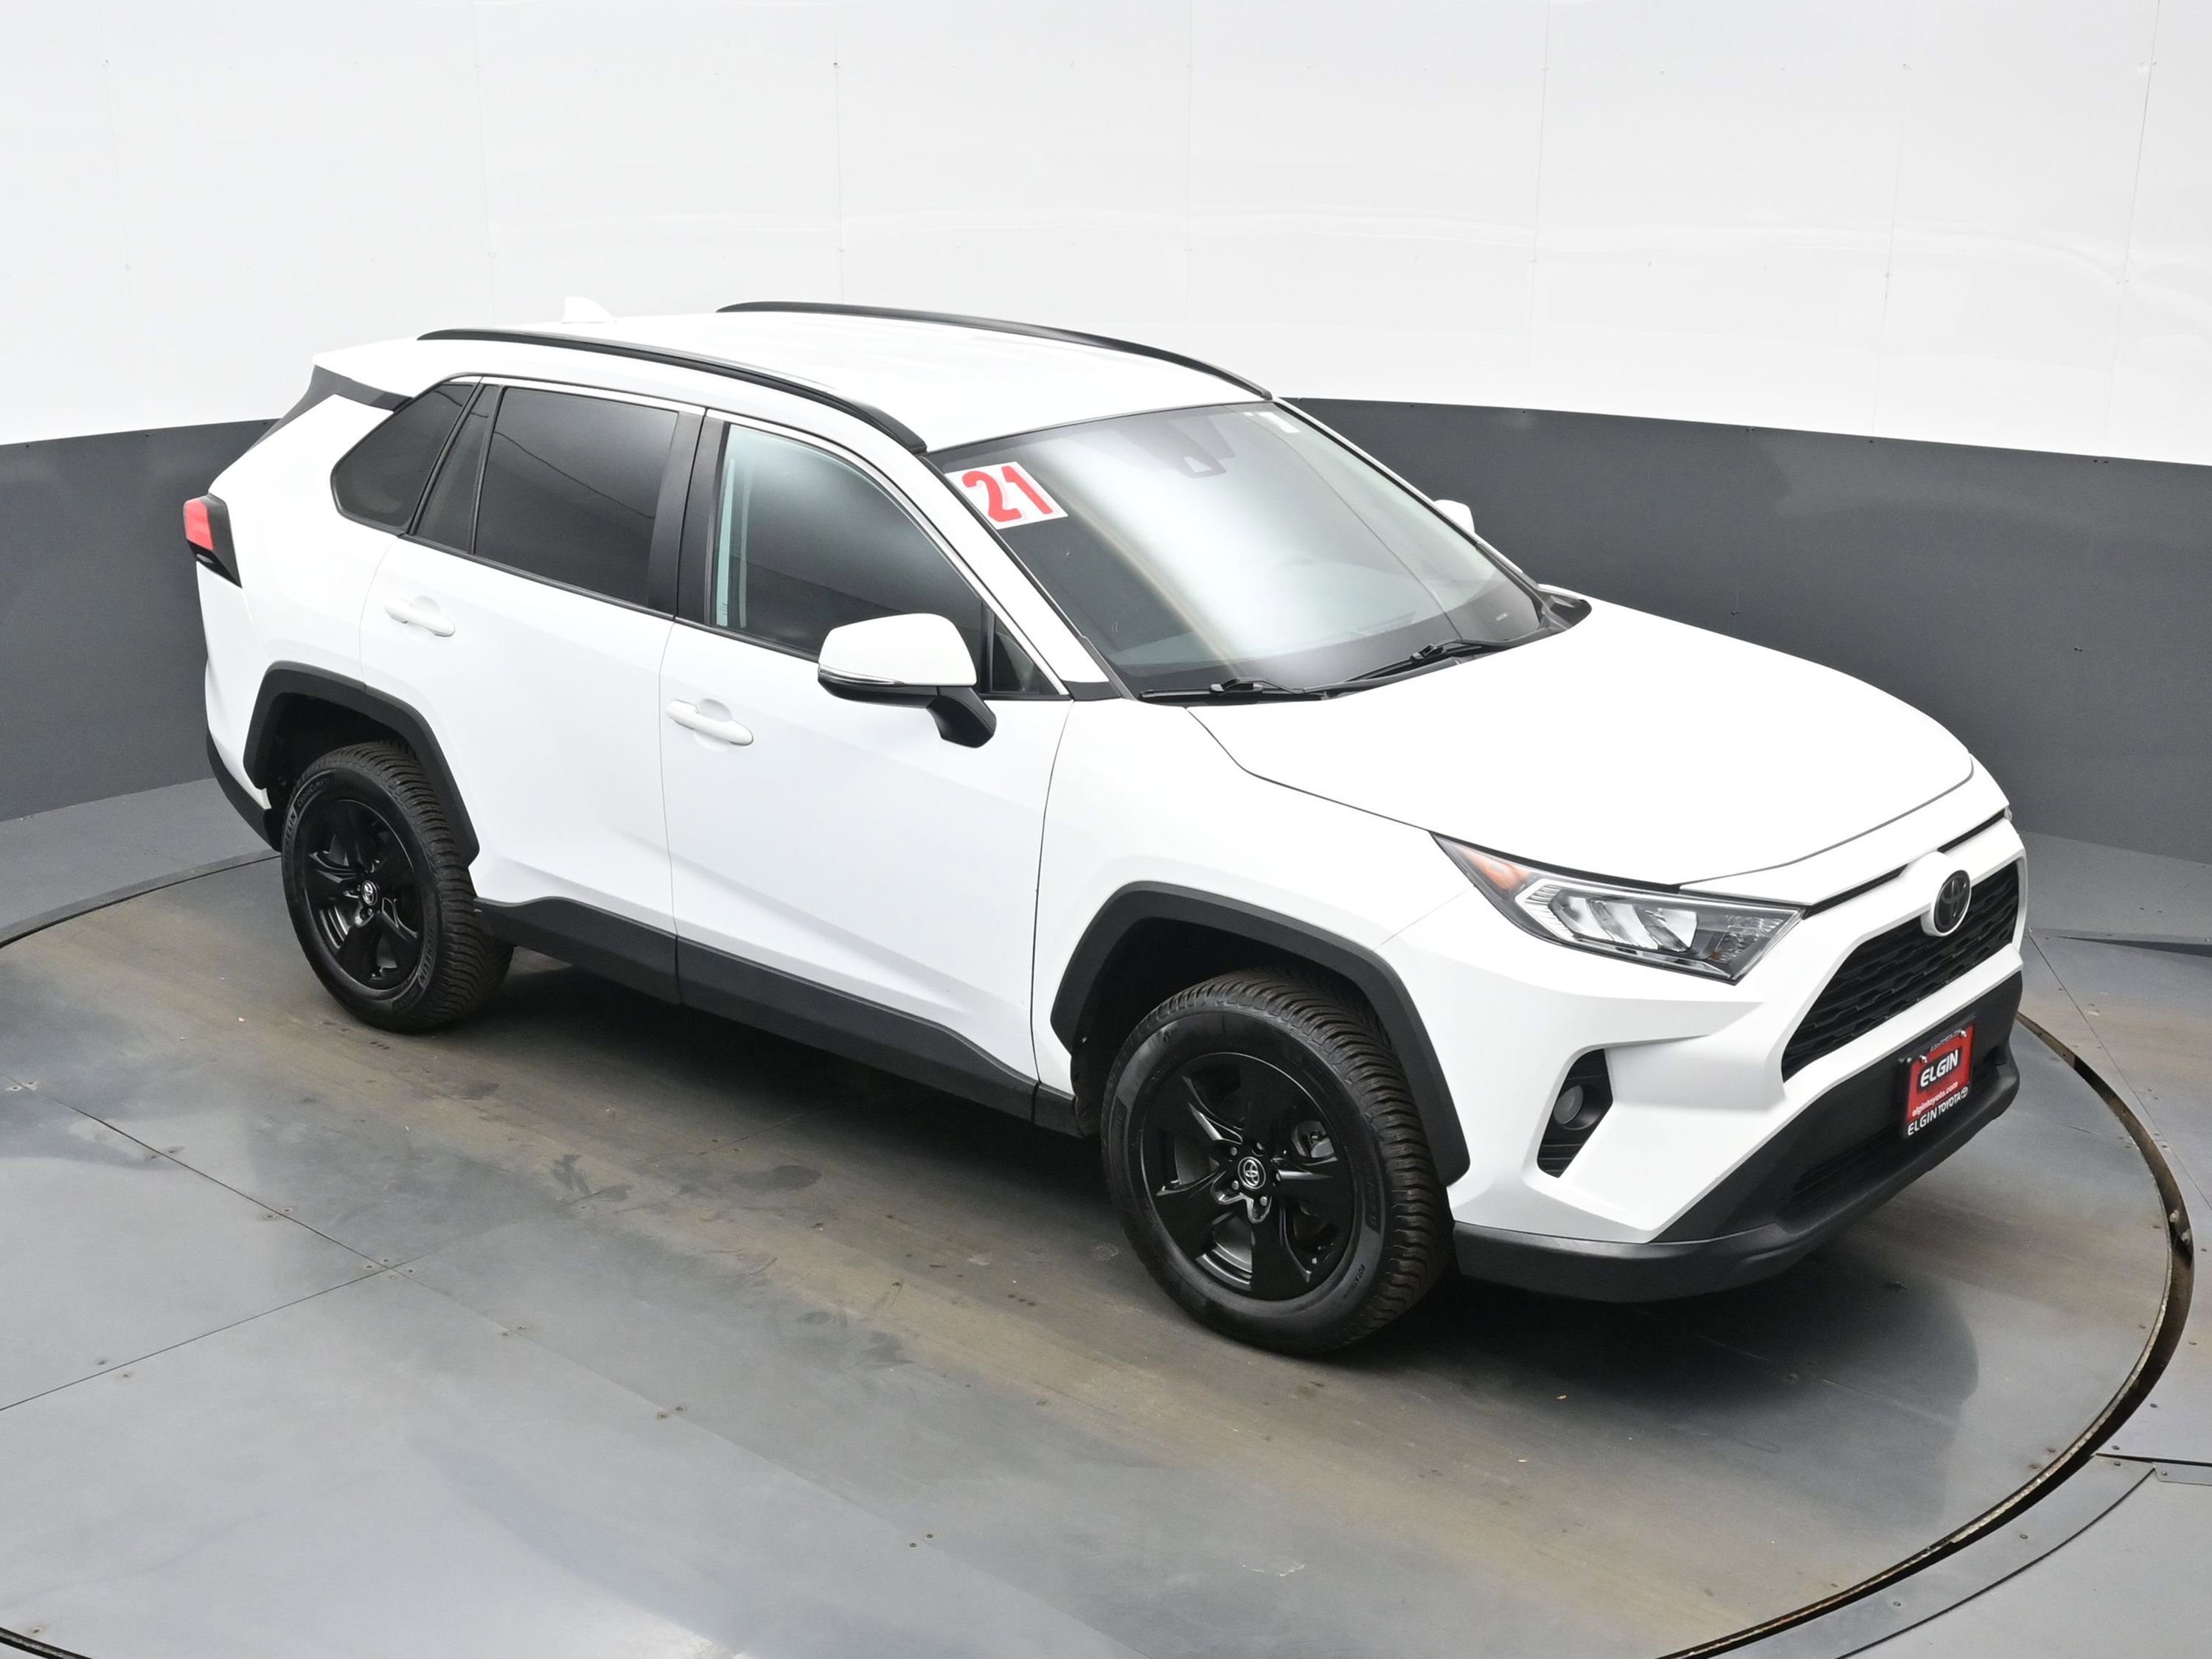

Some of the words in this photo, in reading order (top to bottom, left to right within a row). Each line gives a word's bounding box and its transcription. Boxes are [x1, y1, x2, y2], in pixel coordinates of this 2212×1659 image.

[962, 465, 1053, 522] 21
[1920, 1048, 1958, 1088] ELGIN
[1907, 1107, 1937, 1135] ELGIN
[1938, 1091, 1961, 1115] TOYOTA
[1345, 1263, 1366, 1295] ROTATIO
